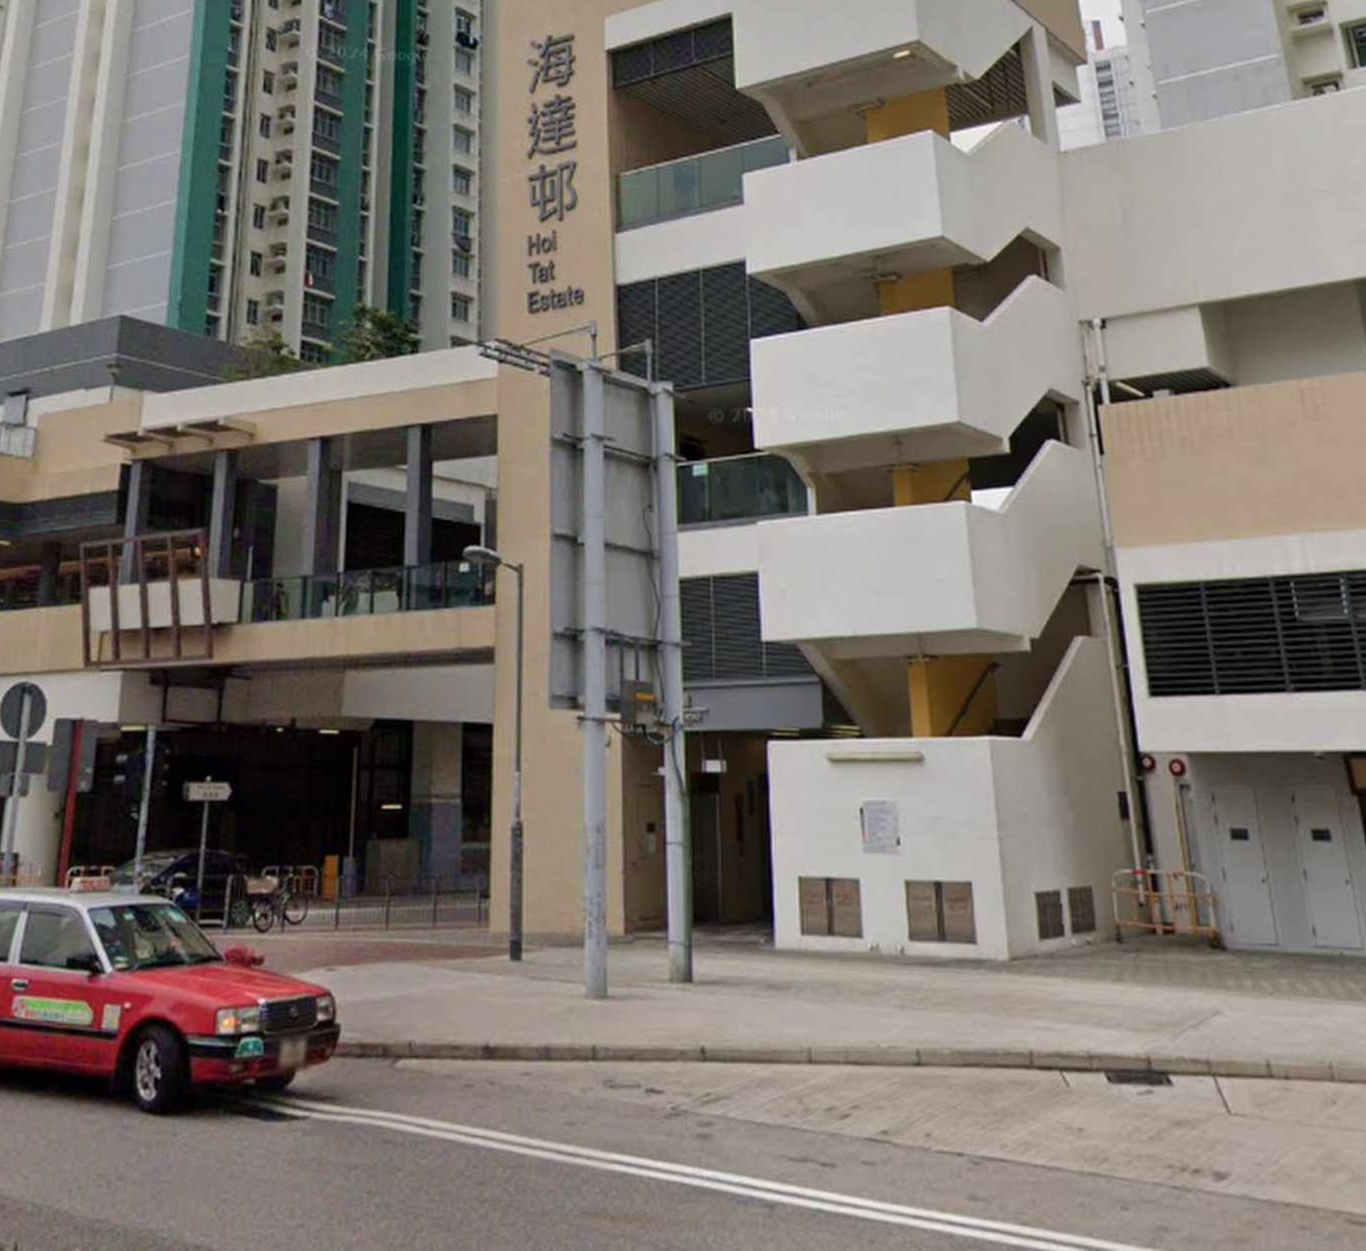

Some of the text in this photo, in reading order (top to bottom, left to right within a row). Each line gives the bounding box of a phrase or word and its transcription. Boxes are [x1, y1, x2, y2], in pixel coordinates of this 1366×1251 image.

[526, 33, 578, 223] 海達邨
[527, 231, 557, 256] Hoi
[528, 263, 556, 284] Tat
[528, 286, 585, 314] Estate
